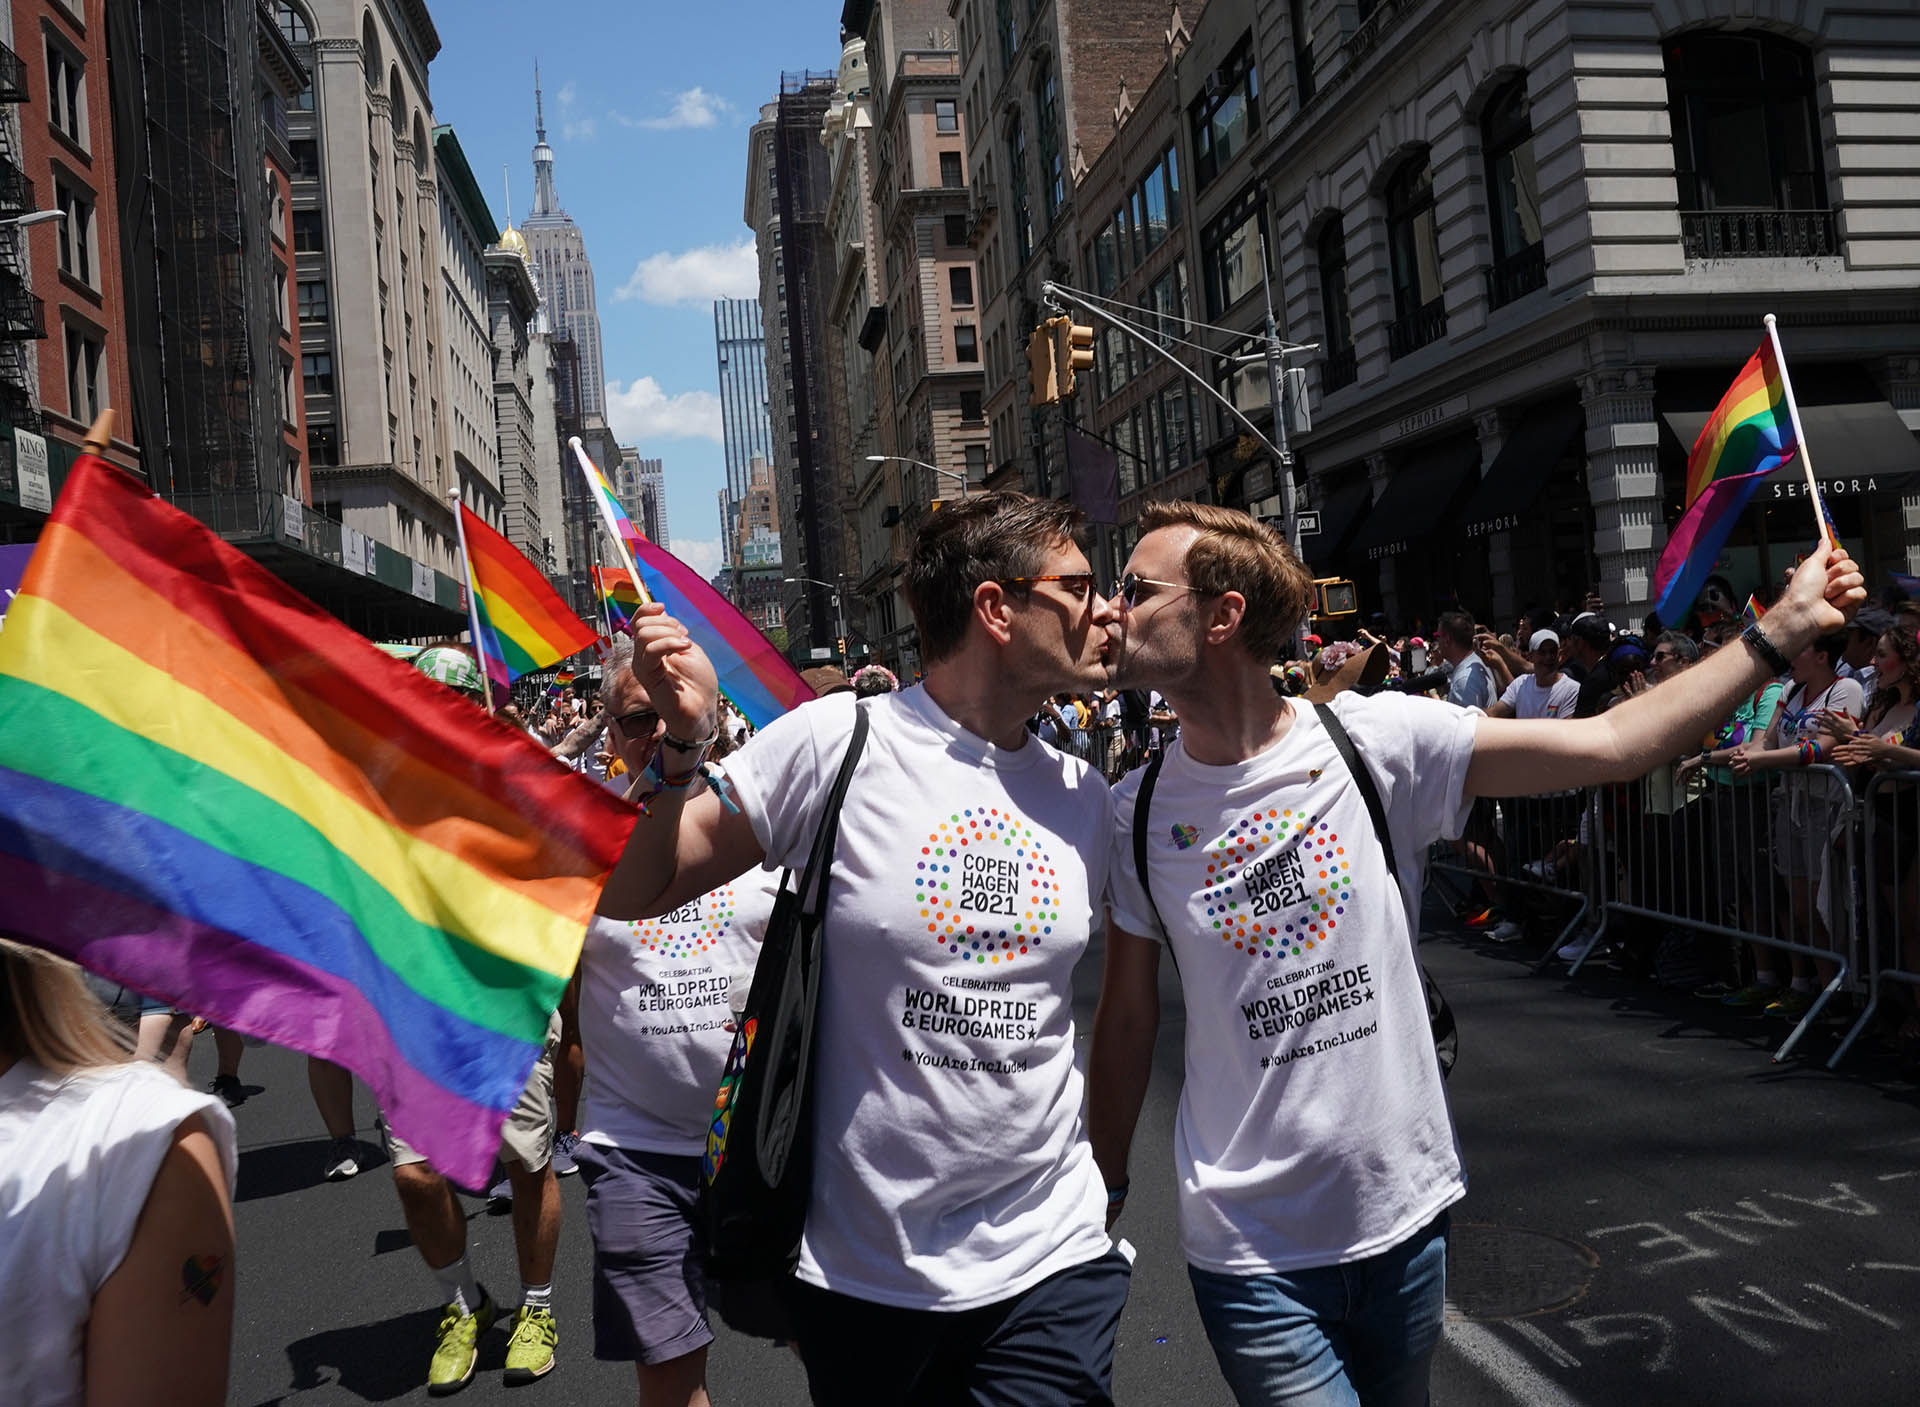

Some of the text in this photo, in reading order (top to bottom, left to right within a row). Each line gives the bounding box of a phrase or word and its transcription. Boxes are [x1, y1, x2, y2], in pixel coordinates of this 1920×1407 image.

[1400, 407, 1444, 435] SEPHORA
[20, 435, 45, 459] KINGS
[1774, 478, 1877, 498] SEPHORA
[1467, 514, 1519, 537] SEPHORA
[1368, 540, 1408, 560] SEPHORA
[963, 854, 1019, 877] COPEN
[1243, 847, 1301, 881] COPEN
[962, 871, 1018, 894] HAGEN
[1245, 864, 1306, 898] HAGEN
[960, 889, 1018, 916] 2021
[1251, 882, 1311, 918] 2021
[660, 908, 702, 924] 2021
[659, 966, 713, 978] CELEBRATING
[1266, 959, 1335, 990] CELEBRATING
[639, 976, 733, 998] WORLDPRID
[942, 976, 1011, 993] CELEBRATING
[1241, 964, 1371, 1022] WORLDPRIDE
[905, 987, 1037, 1021] WORLDPRIDE
[1260, 1021, 1378, 1069] #YouAreIncluded
[902, 1049, 1027, 1074] #YouAreIncluded
